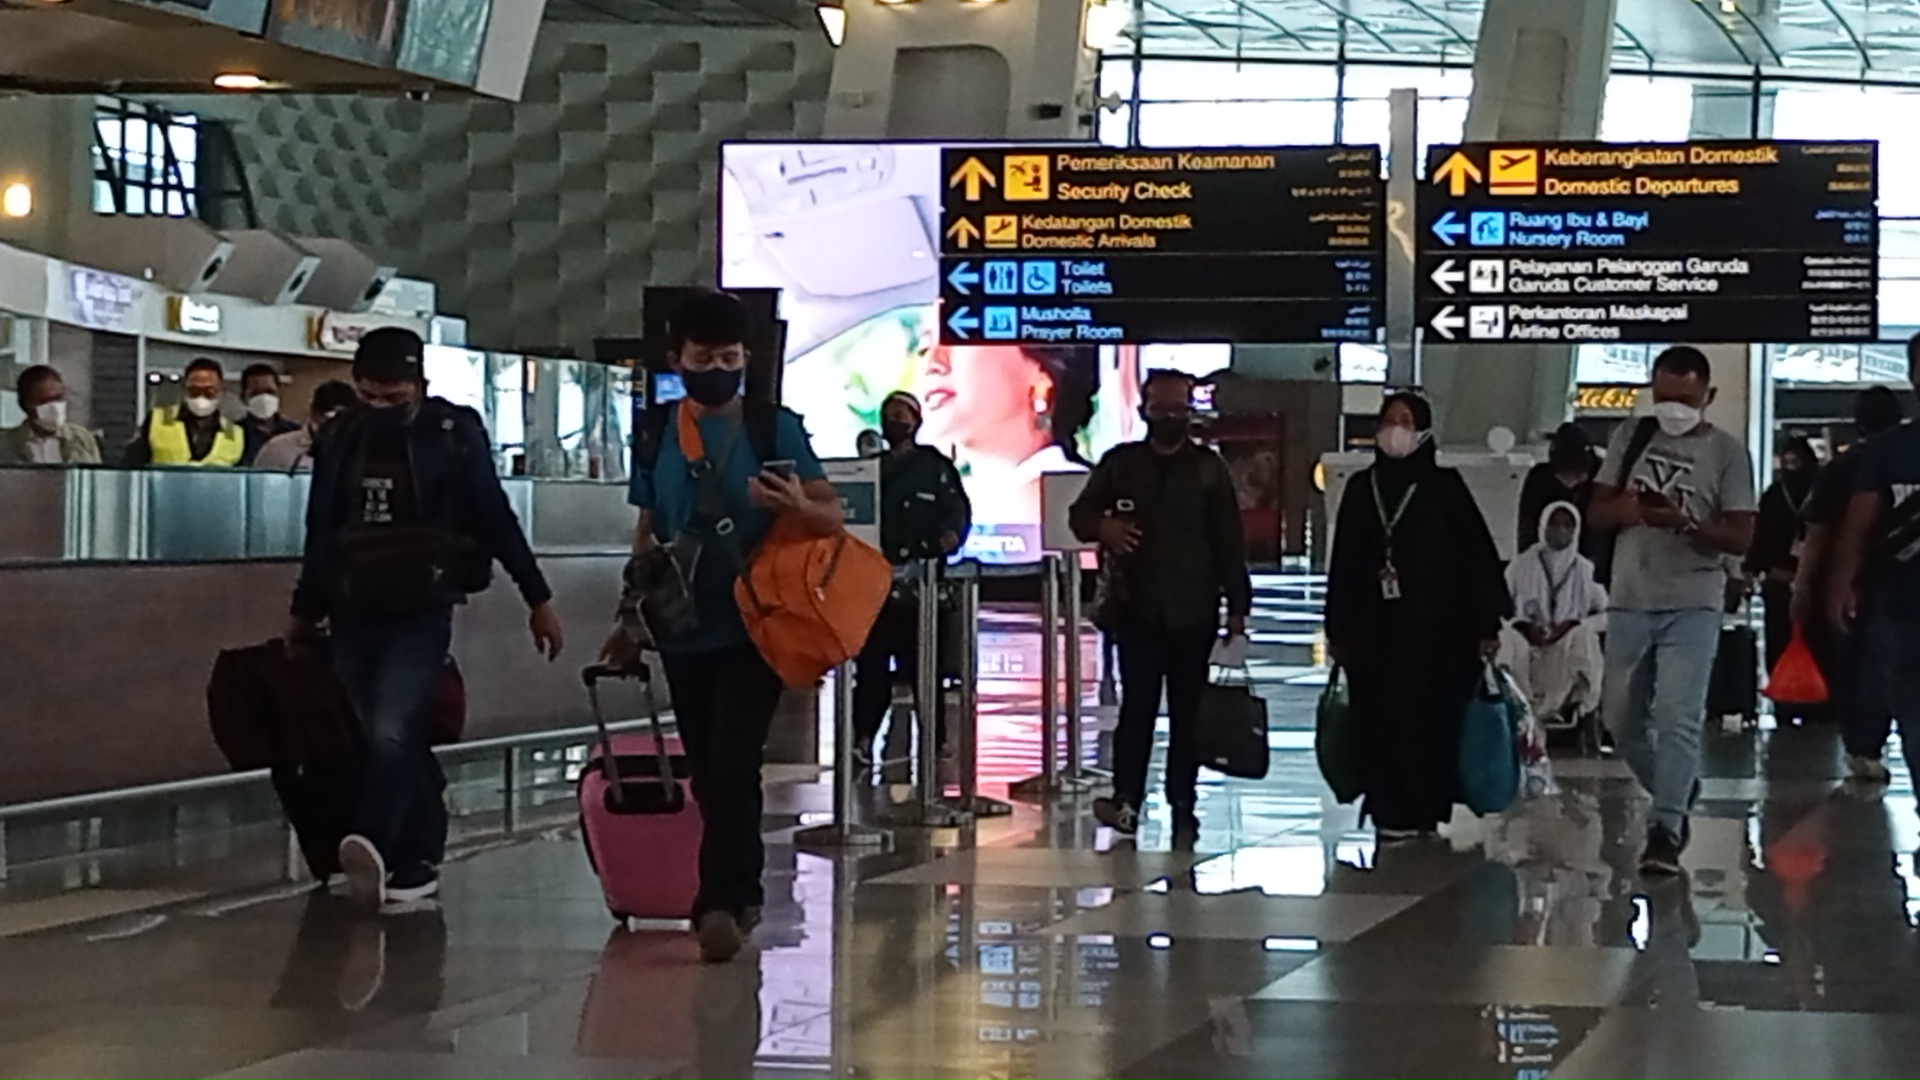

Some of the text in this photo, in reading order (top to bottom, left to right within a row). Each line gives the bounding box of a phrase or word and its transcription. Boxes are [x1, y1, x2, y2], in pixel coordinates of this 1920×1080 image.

[1057, 153, 1275, 171] Pemeriksaan Keamanan
[1544, 147, 1778, 168] Keberangkatan Domestik
[1057, 182, 1192, 202] Security Check
[1544, 177, 1739, 197] Domestic Departures
[1022, 214, 1192, 233] Kedatangan Domestik
[1509, 211, 1649, 230] Ruang Ibu & Bayi
[1022, 233, 1156, 248] Domestic Arrivals
[1509, 230, 1625, 249] Nursery Room
[1061, 260, 1105, 276] Toilet
[1509, 258, 1749, 278] Pelayanan Pelanggan Garuda
[1061, 279, 1113, 295] Toilets
[1509, 275, 1718, 293] Garuda Customer Service
[1021, 306, 1092, 320] Musholla
[1509, 304, 1688, 322] Perkantoran Maskapai
[1021, 324, 1123, 341] Prayer Room
[1509, 323, 1620, 339] Airline Offices
